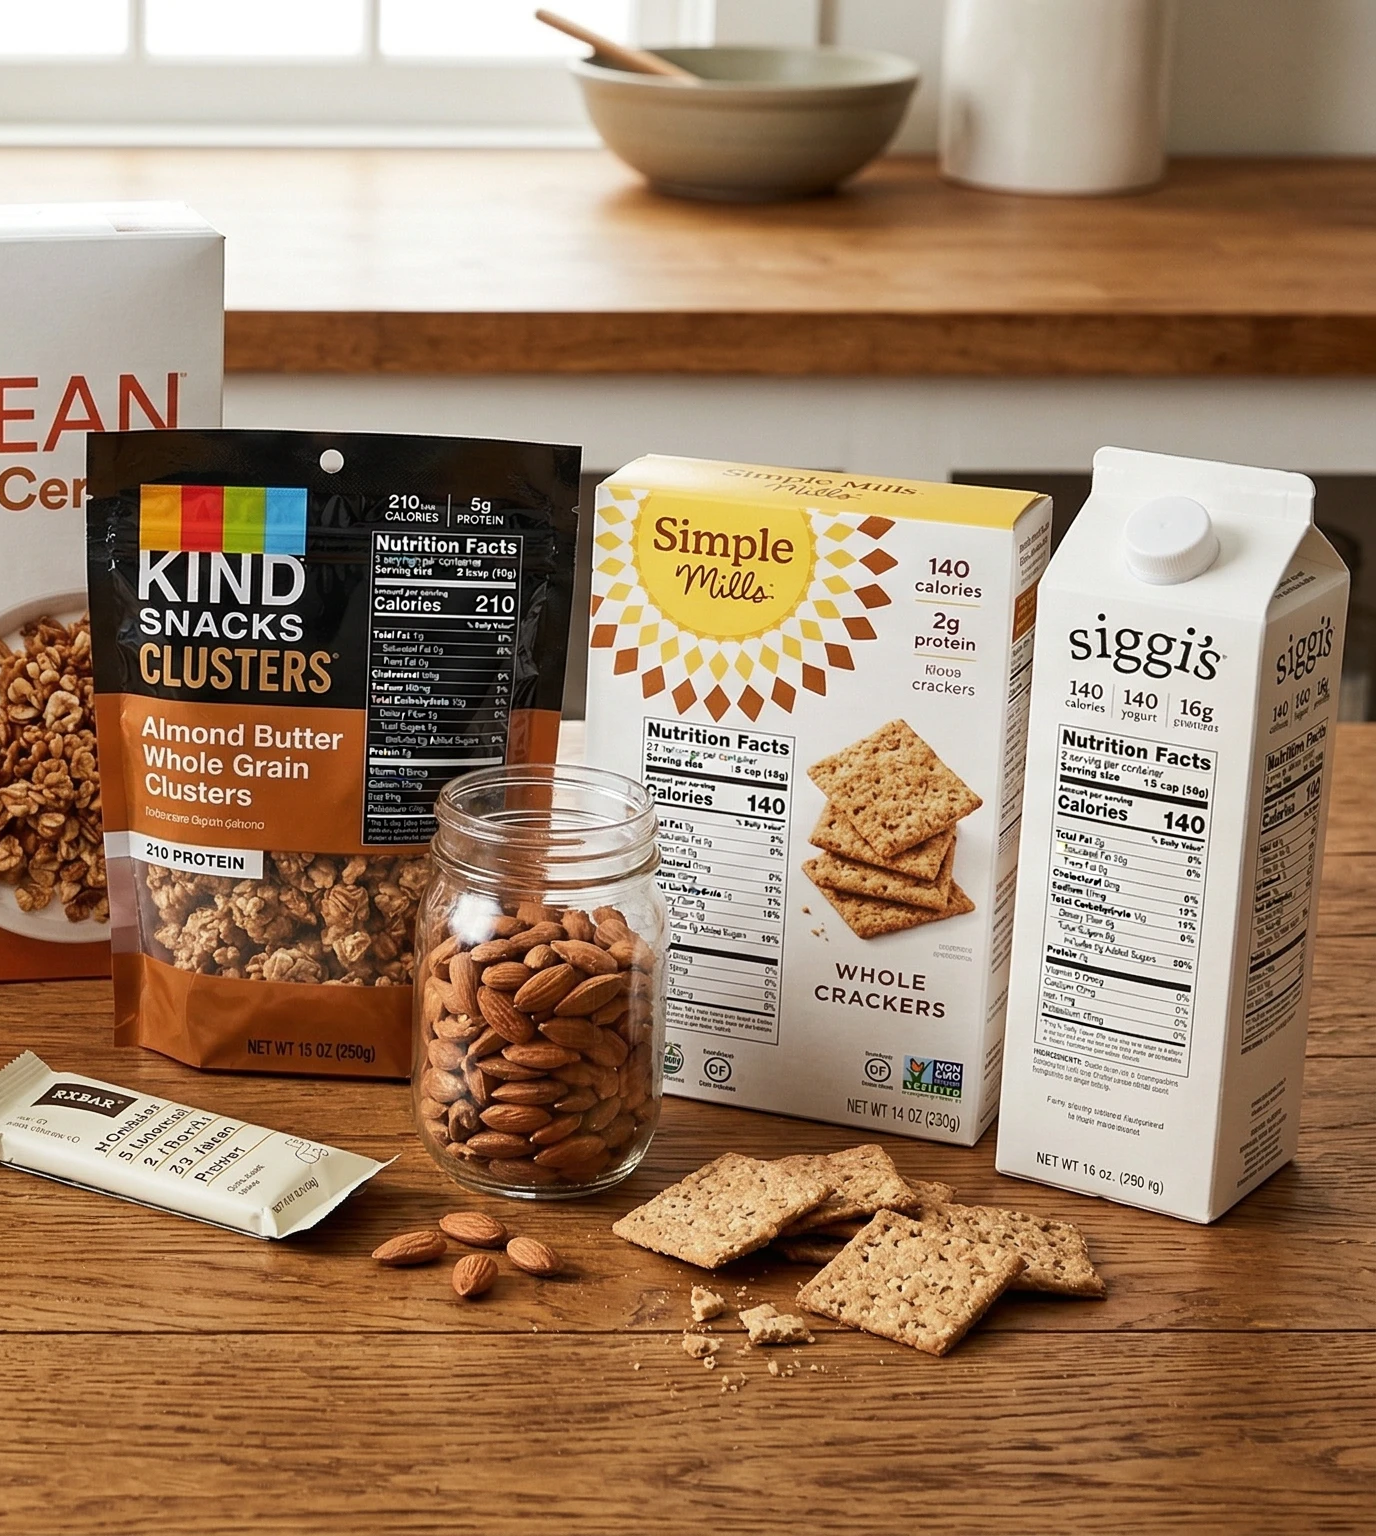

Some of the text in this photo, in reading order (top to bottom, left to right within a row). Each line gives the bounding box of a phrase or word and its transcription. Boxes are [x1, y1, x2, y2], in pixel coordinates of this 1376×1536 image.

[722, 468, 919, 496] Simple Mills
[388, 494, 492, 514] 210 5g
[385, 511, 504, 526] CALORIES PROTEIN
[376, 534, 517, 555] Nutrition Facts
[653, 516, 795, 568] Simple
[138, 549, 306, 606] KIND
[927, 557, 971, 580] 140
[675, 563, 773, 604] Mills
[915, 579, 983, 600] calories
[374, 594, 515, 614] Calories 210
[139, 607, 304, 642] SNACKS
[932, 612, 961, 634] 2g
[915, 635, 976, 652] protein
[1068, 613, 1222, 682] siggi's
[1276, 615, 1335, 686] siggi's
[139, 642, 332, 694] CLUSTERS
[912, 681, 976, 697] crackers
[1069, 680, 1214, 723] 140 140 16g
[1064, 698, 1158, 723] calories yogurt
[142, 716, 344, 750] Almond Butter
[647, 722, 731, 748] Nutrition
[737, 734, 790, 756] Facts
[142, 744, 309, 780] Whole Grain
[1062, 729, 1212, 771] Nutrition Facts
[145, 772, 252, 807] Clusters
[645, 784, 786, 815] Calories 140
[1058, 794, 1206, 834] Calories 140
[146, 842, 244, 870] 210 PROTEIN
[1187, 855, 1202, 865] 0%
[1186, 868, 1201, 878] 0%
[1184, 895, 1199, 905] 0%
[835, 962, 927, 992] WHOLE
[814, 985, 946, 1019] CRACKERS
[1175, 1006, 1189, 1016] 0%
[1176, 993, 1190, 1003] 0%
[1173, 1031, 1186, 1041] 0%
[1174, 1018, 1187, 1028] 0%
[247, 1039, 272, 1055] NET
[274, 1041, 295, 1056] WT
[316, 1043, 333, 1059] OZ
[336, 1044, 376, 1063] (250g)
[936, 1062, 961, 1073] NON
[52, 1089, 116, 1110] RXBAR
[847, 1098, 869, 1115] NET
[871, 1101, 888, 1118] WT
[892, 1106, 904, 1122] 14
[908, 1107, 923, 1124] OZ
[1036, 1151, 1116, 1182] NET WT 16 oz.
